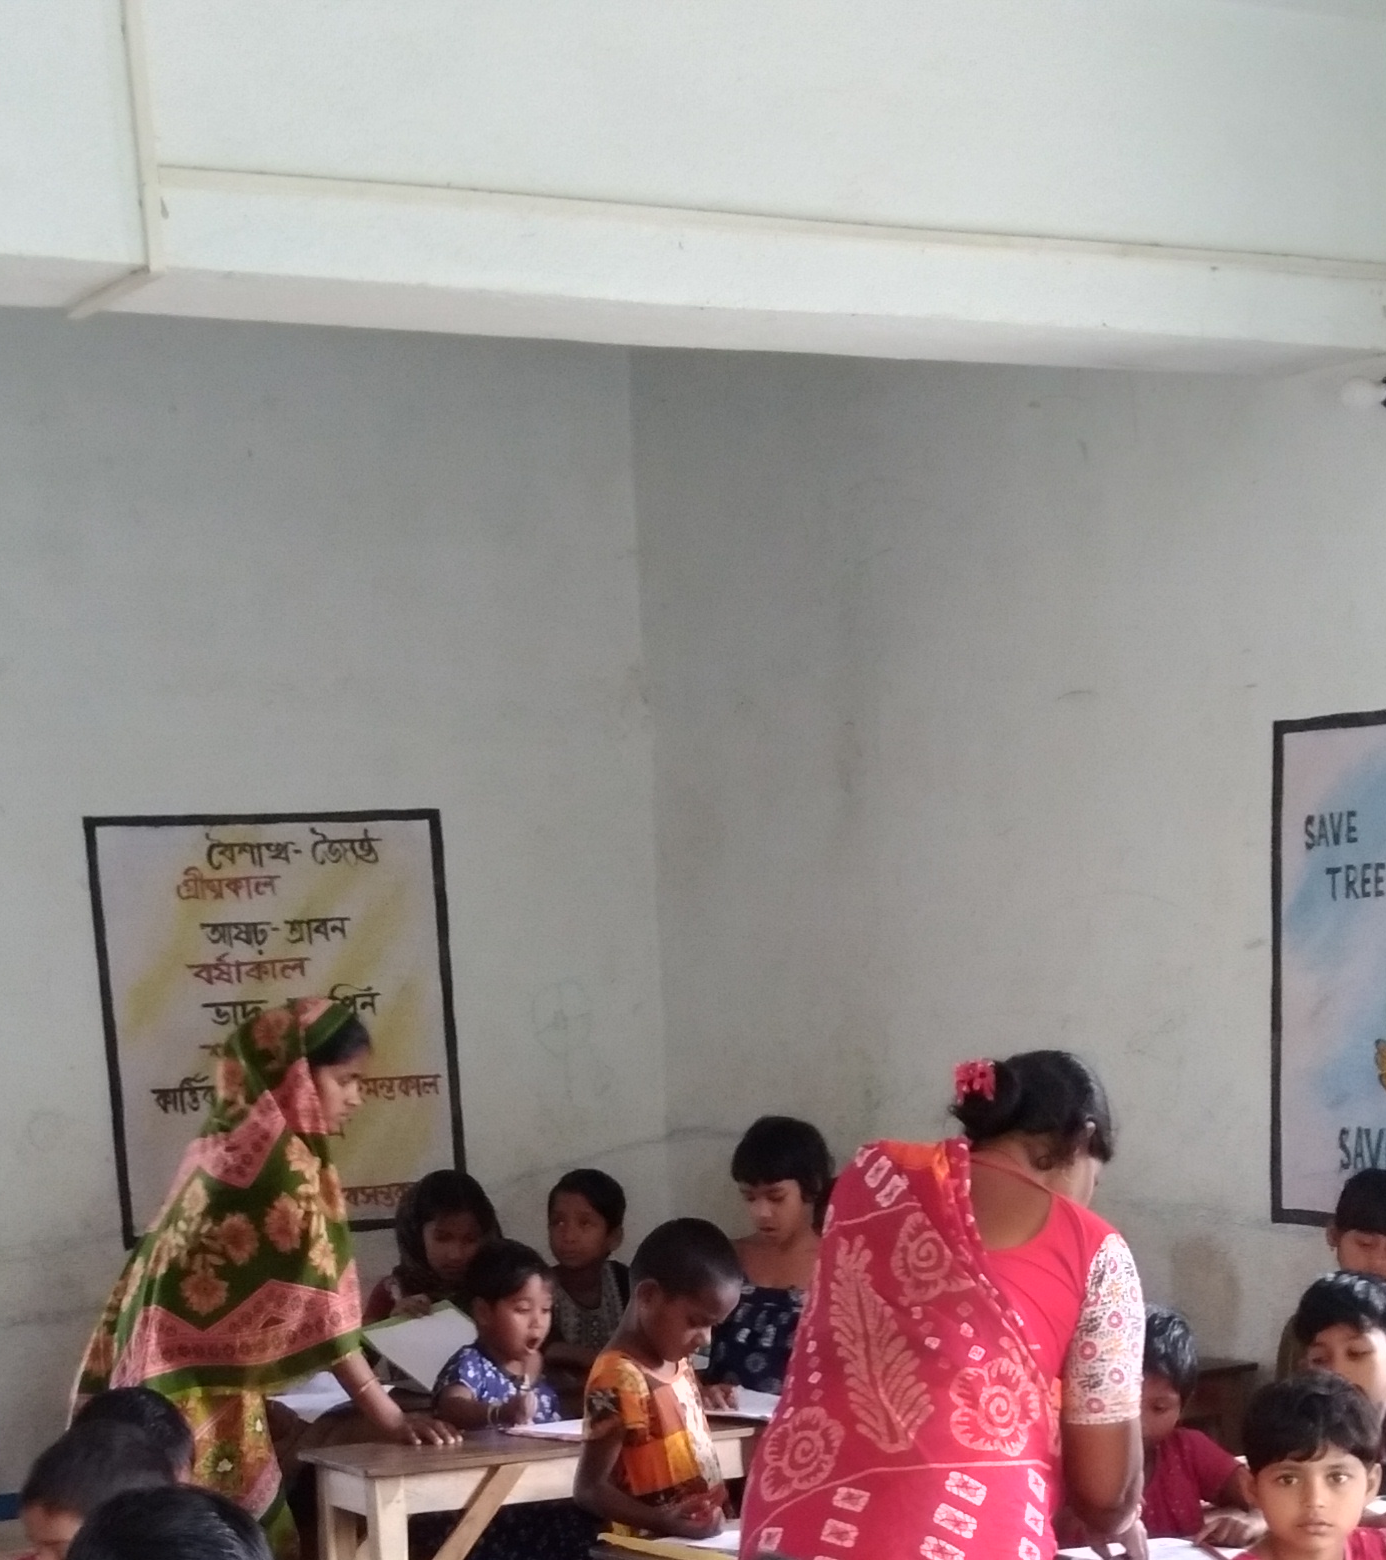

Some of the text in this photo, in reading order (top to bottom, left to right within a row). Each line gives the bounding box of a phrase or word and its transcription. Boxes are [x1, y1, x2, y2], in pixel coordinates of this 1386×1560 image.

[1303, 810, 1358, 850] SAVE
[185, 952, 311, 984] বর্ষাকাল
[359, 1075, 440, 1100] মন্তকাল
